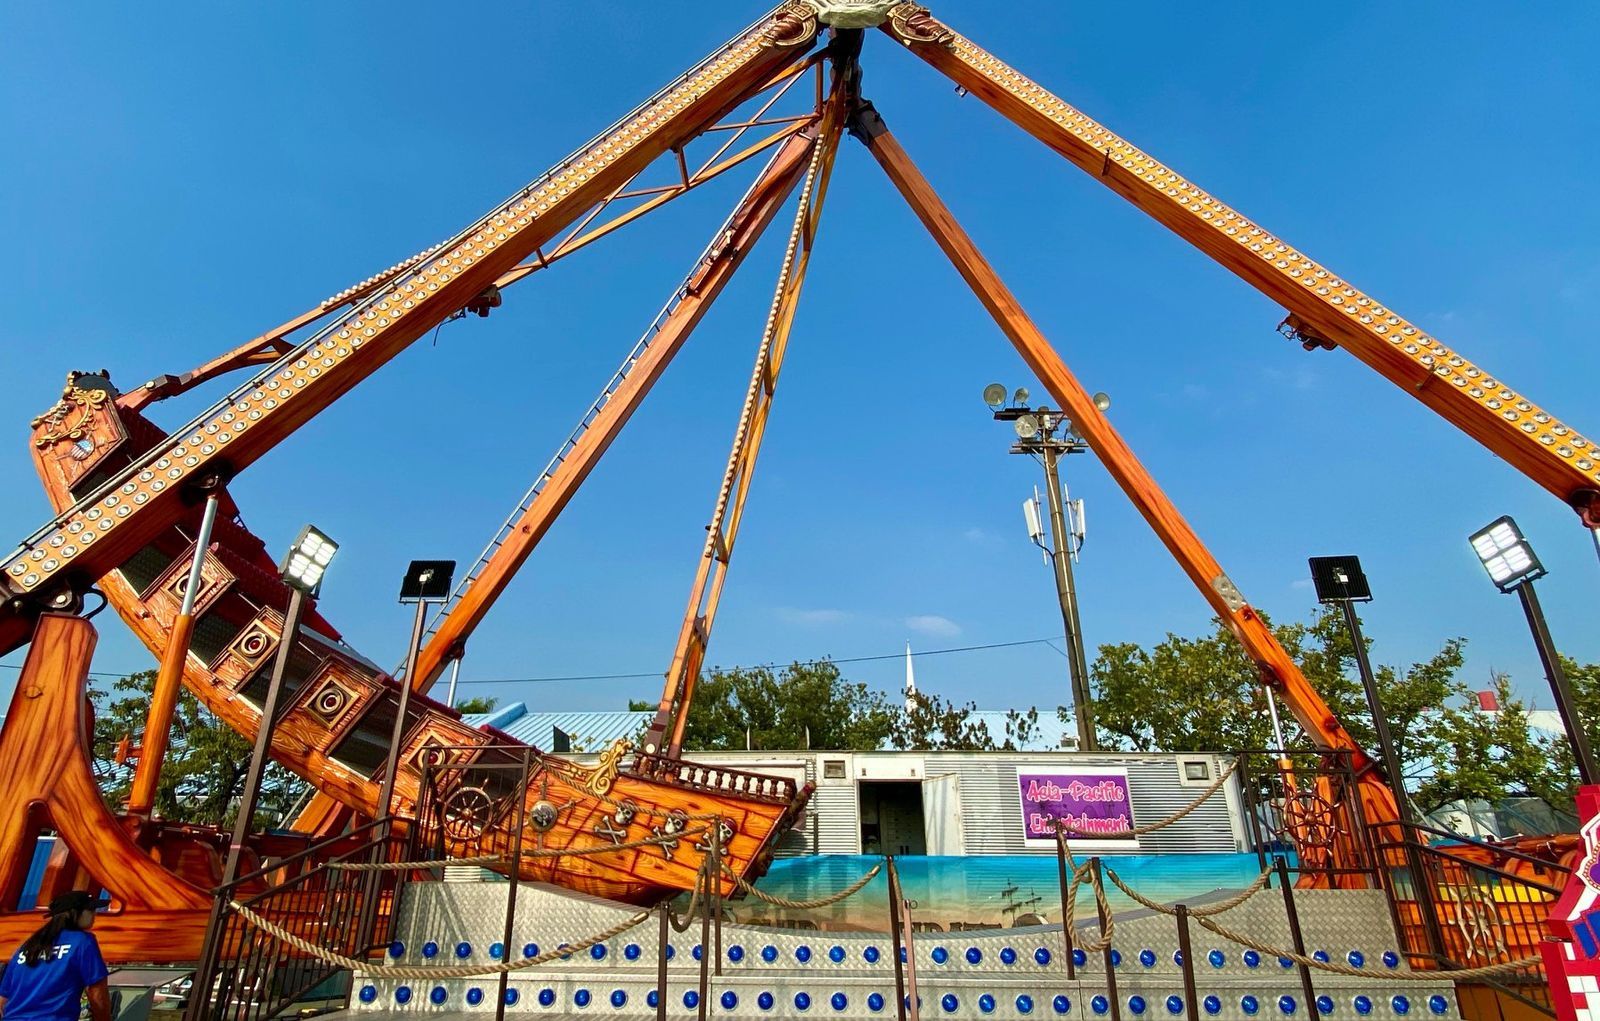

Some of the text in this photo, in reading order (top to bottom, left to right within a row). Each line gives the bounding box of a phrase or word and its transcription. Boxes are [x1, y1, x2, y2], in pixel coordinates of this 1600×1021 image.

[1026, 780, 1125, 802] Asia-Pacific
[1030, 812, 1130, 834] Entetainment
[17, 944, 71, 965] SAFF
